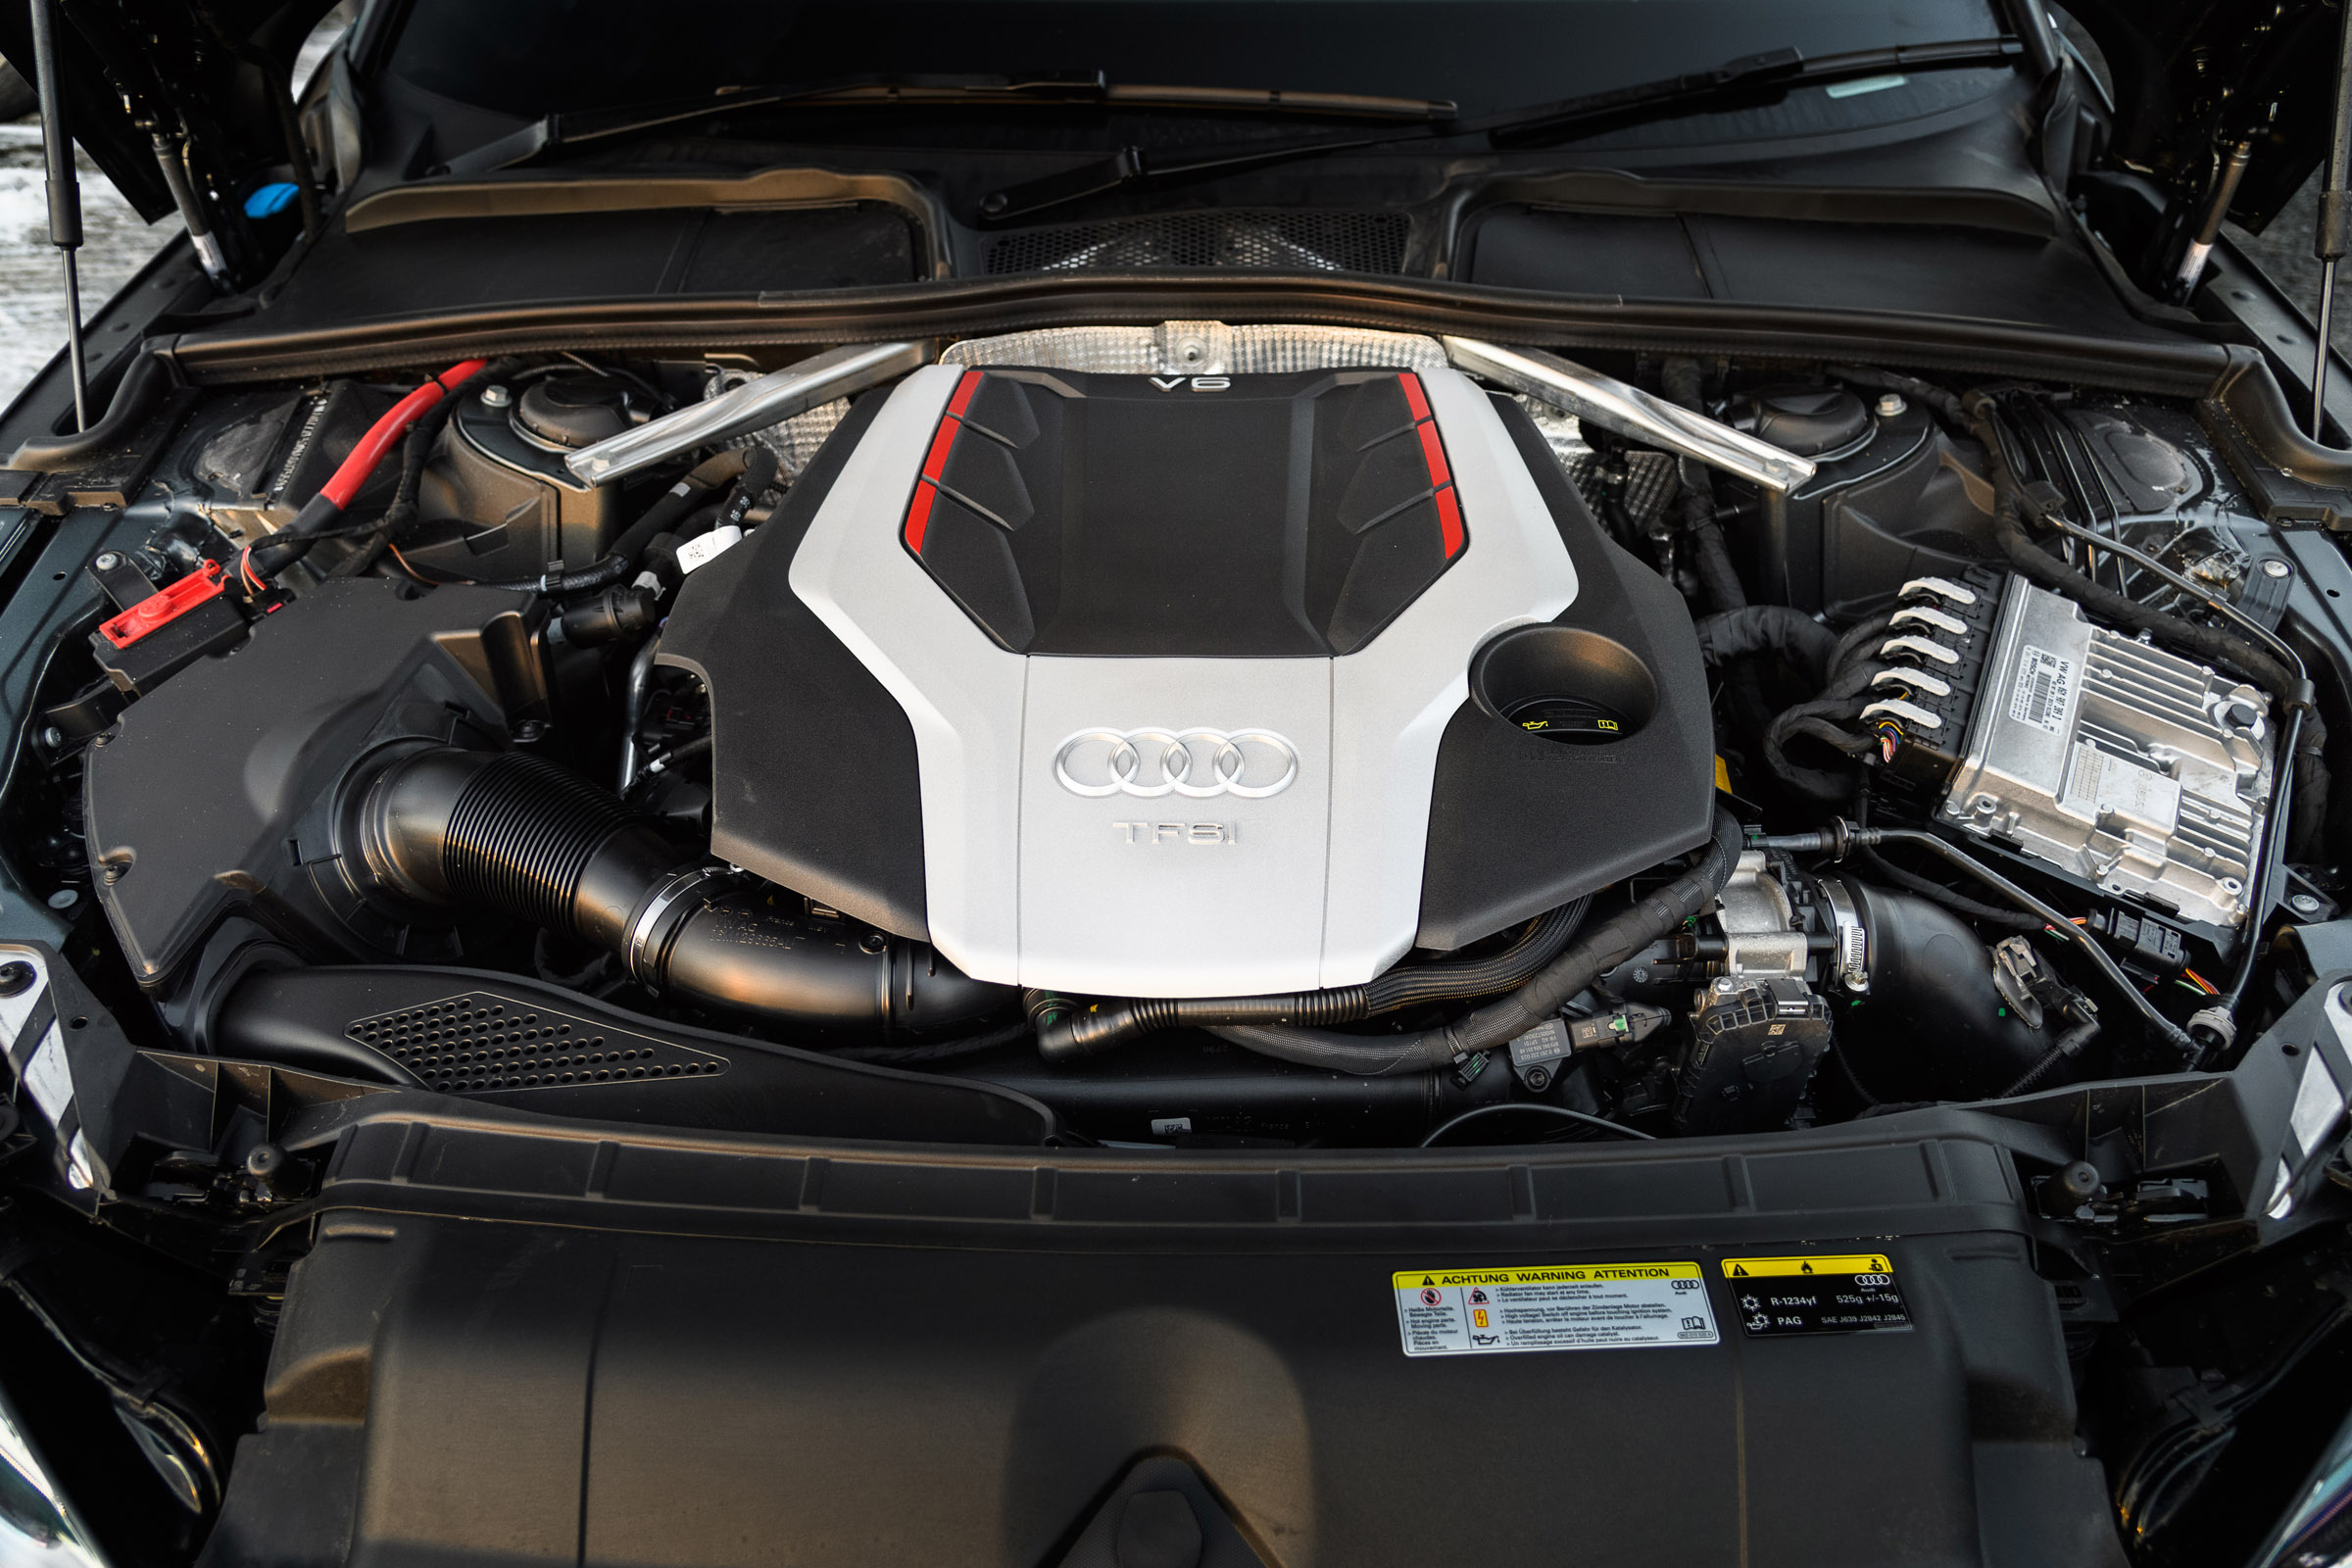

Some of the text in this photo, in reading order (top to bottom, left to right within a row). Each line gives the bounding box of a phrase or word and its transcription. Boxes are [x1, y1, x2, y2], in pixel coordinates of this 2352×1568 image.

[1149, 377, 1231, 392] V6
[1112, 822, 1237, 845] TFSI
[1442, 1268, 1669, 1284] ACHTUNG WARNING ATTENTION
[1770, 1295, 1898, 1306] R-1234yf 525g +/-15g
[1777, 1316, 1802, 1325] PAG
